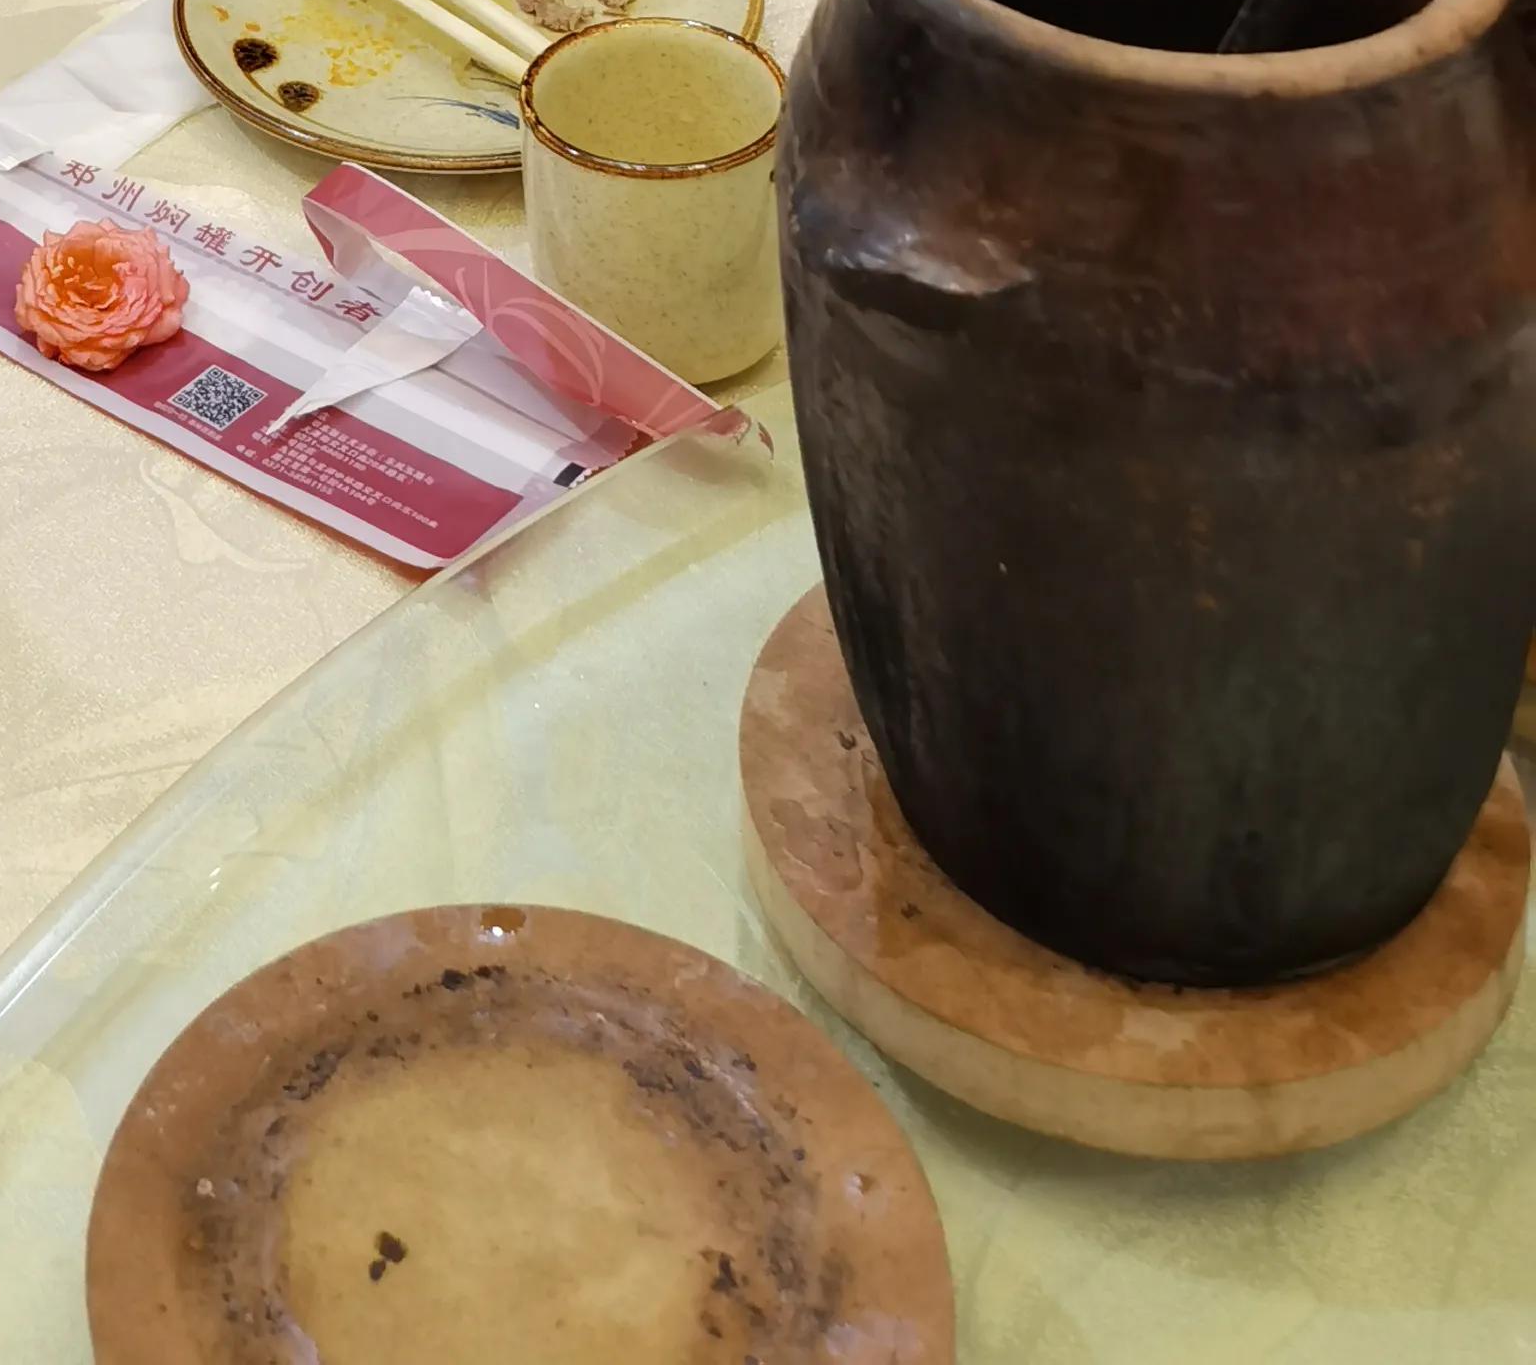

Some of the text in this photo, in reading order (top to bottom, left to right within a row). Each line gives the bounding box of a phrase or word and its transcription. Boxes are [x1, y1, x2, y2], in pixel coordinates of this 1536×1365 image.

[60, 159, 383, 322] 郑州焖罐开创者
